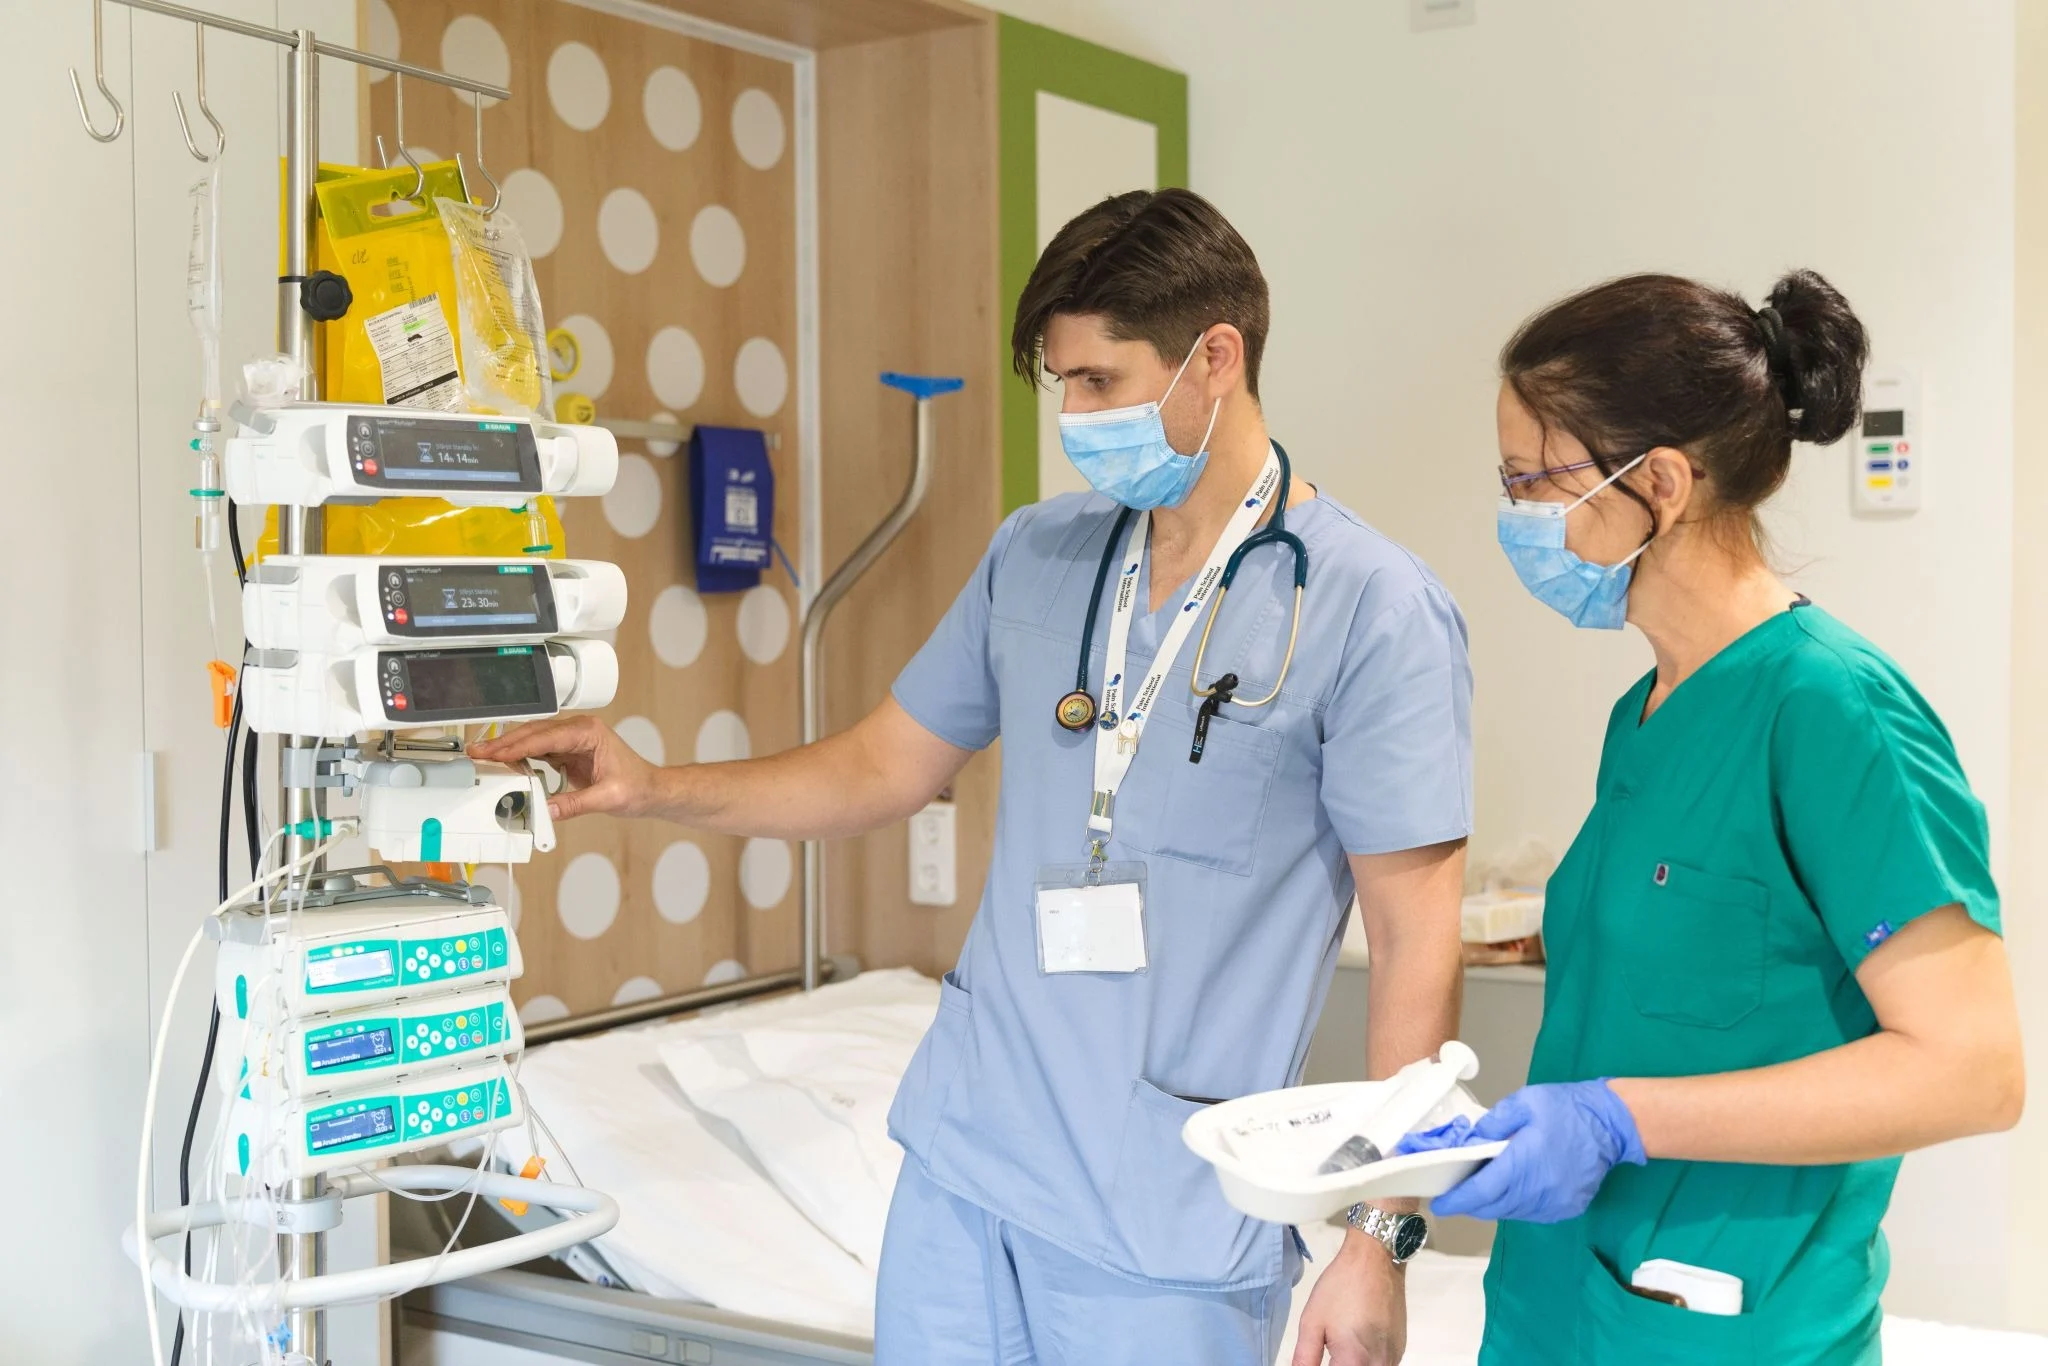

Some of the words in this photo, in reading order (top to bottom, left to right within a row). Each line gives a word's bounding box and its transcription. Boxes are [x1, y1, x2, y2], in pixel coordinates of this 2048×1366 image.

[456, 452, 479, 464] 14min
[1255, 484, 1265, 497] Pain
[1193, 587, 1204, 599] Pain
[1201, 567, 1215, 587] School
[1198, 566, 1221, 601] International
[478, 597, 499, 608] 30min
[1136, 695, 1146, 710] Pain
[1144, 676, 1155, 696] School
[1141, 674, 1162, 712] International
